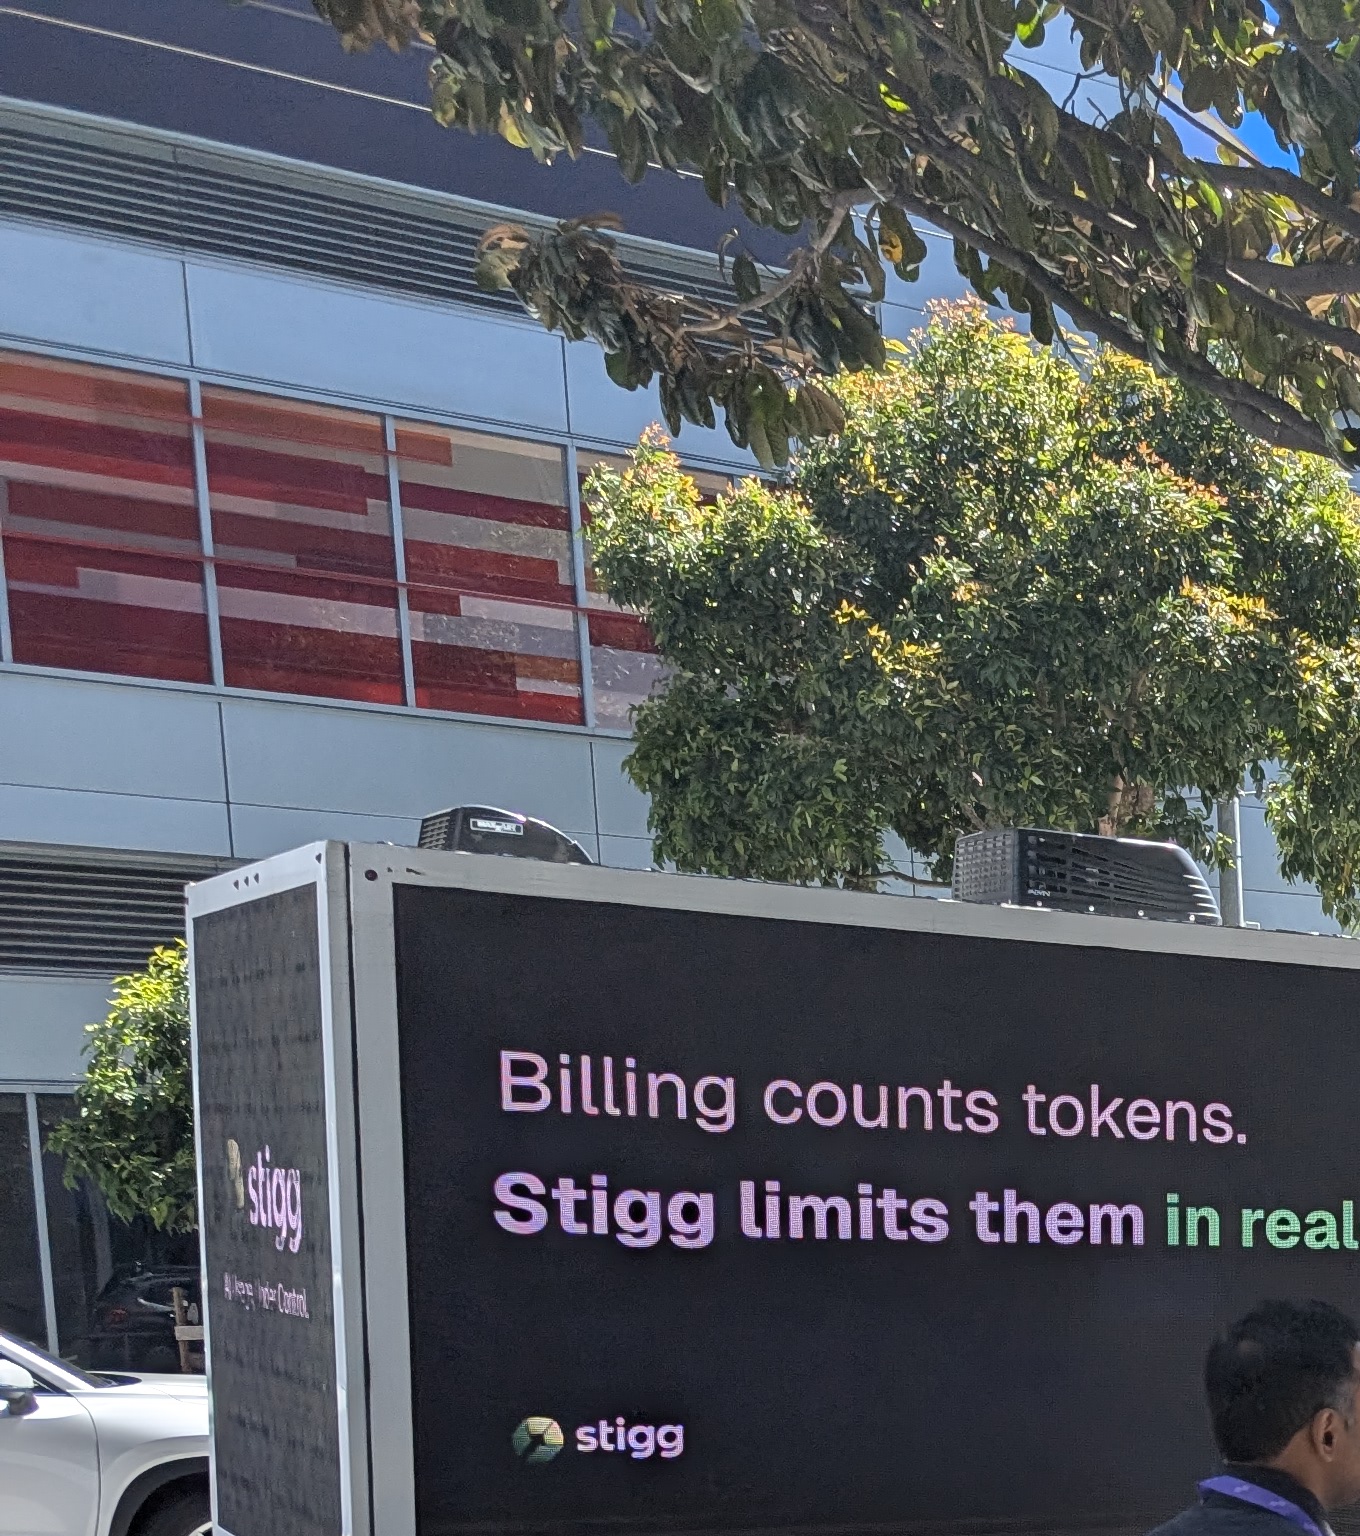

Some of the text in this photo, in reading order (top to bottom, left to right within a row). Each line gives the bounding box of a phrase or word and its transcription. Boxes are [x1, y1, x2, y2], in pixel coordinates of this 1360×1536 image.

[499, 1050, 1247, 1145] Billing counts tokens.
[248, 1144, 302, 1253] stigg
[493, 1171, 715, 1249] Stigg
[740, 1180, 949, 1243] limits
[969, 1188, 1144, 1247] them
[1166, 1192, 1220, 1247] in
[575, 1416, 684, 1459] stigg
